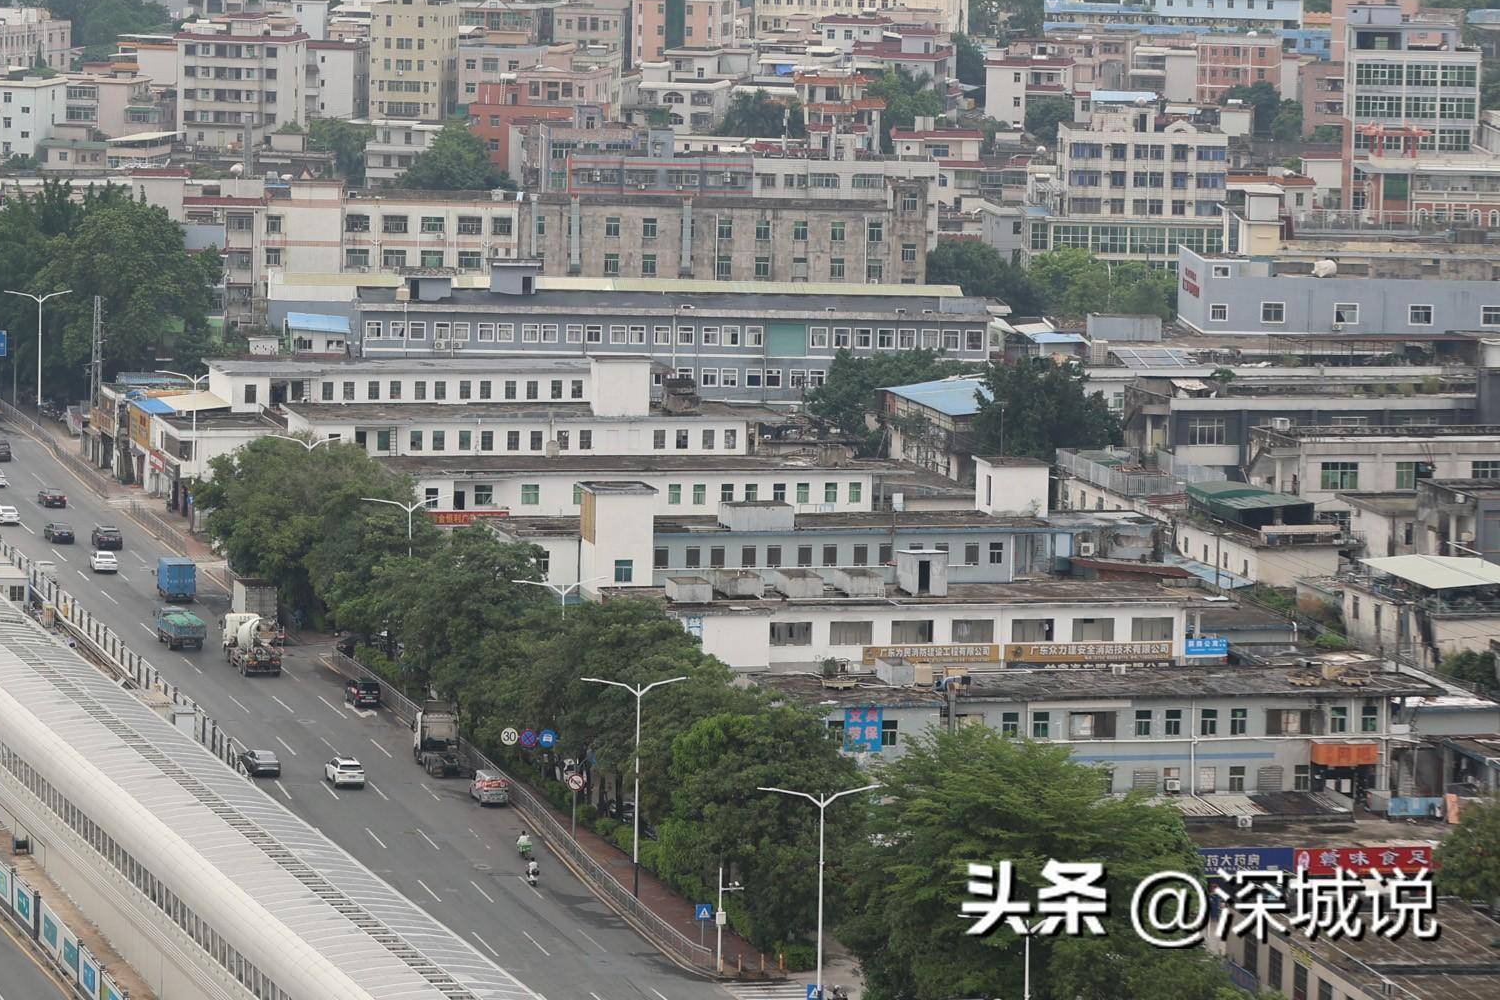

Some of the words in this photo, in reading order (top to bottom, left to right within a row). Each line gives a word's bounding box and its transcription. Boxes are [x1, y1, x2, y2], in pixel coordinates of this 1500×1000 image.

[503, 731, 516, 742] 30
[1201, 854, 1260, 867] 药大药房
